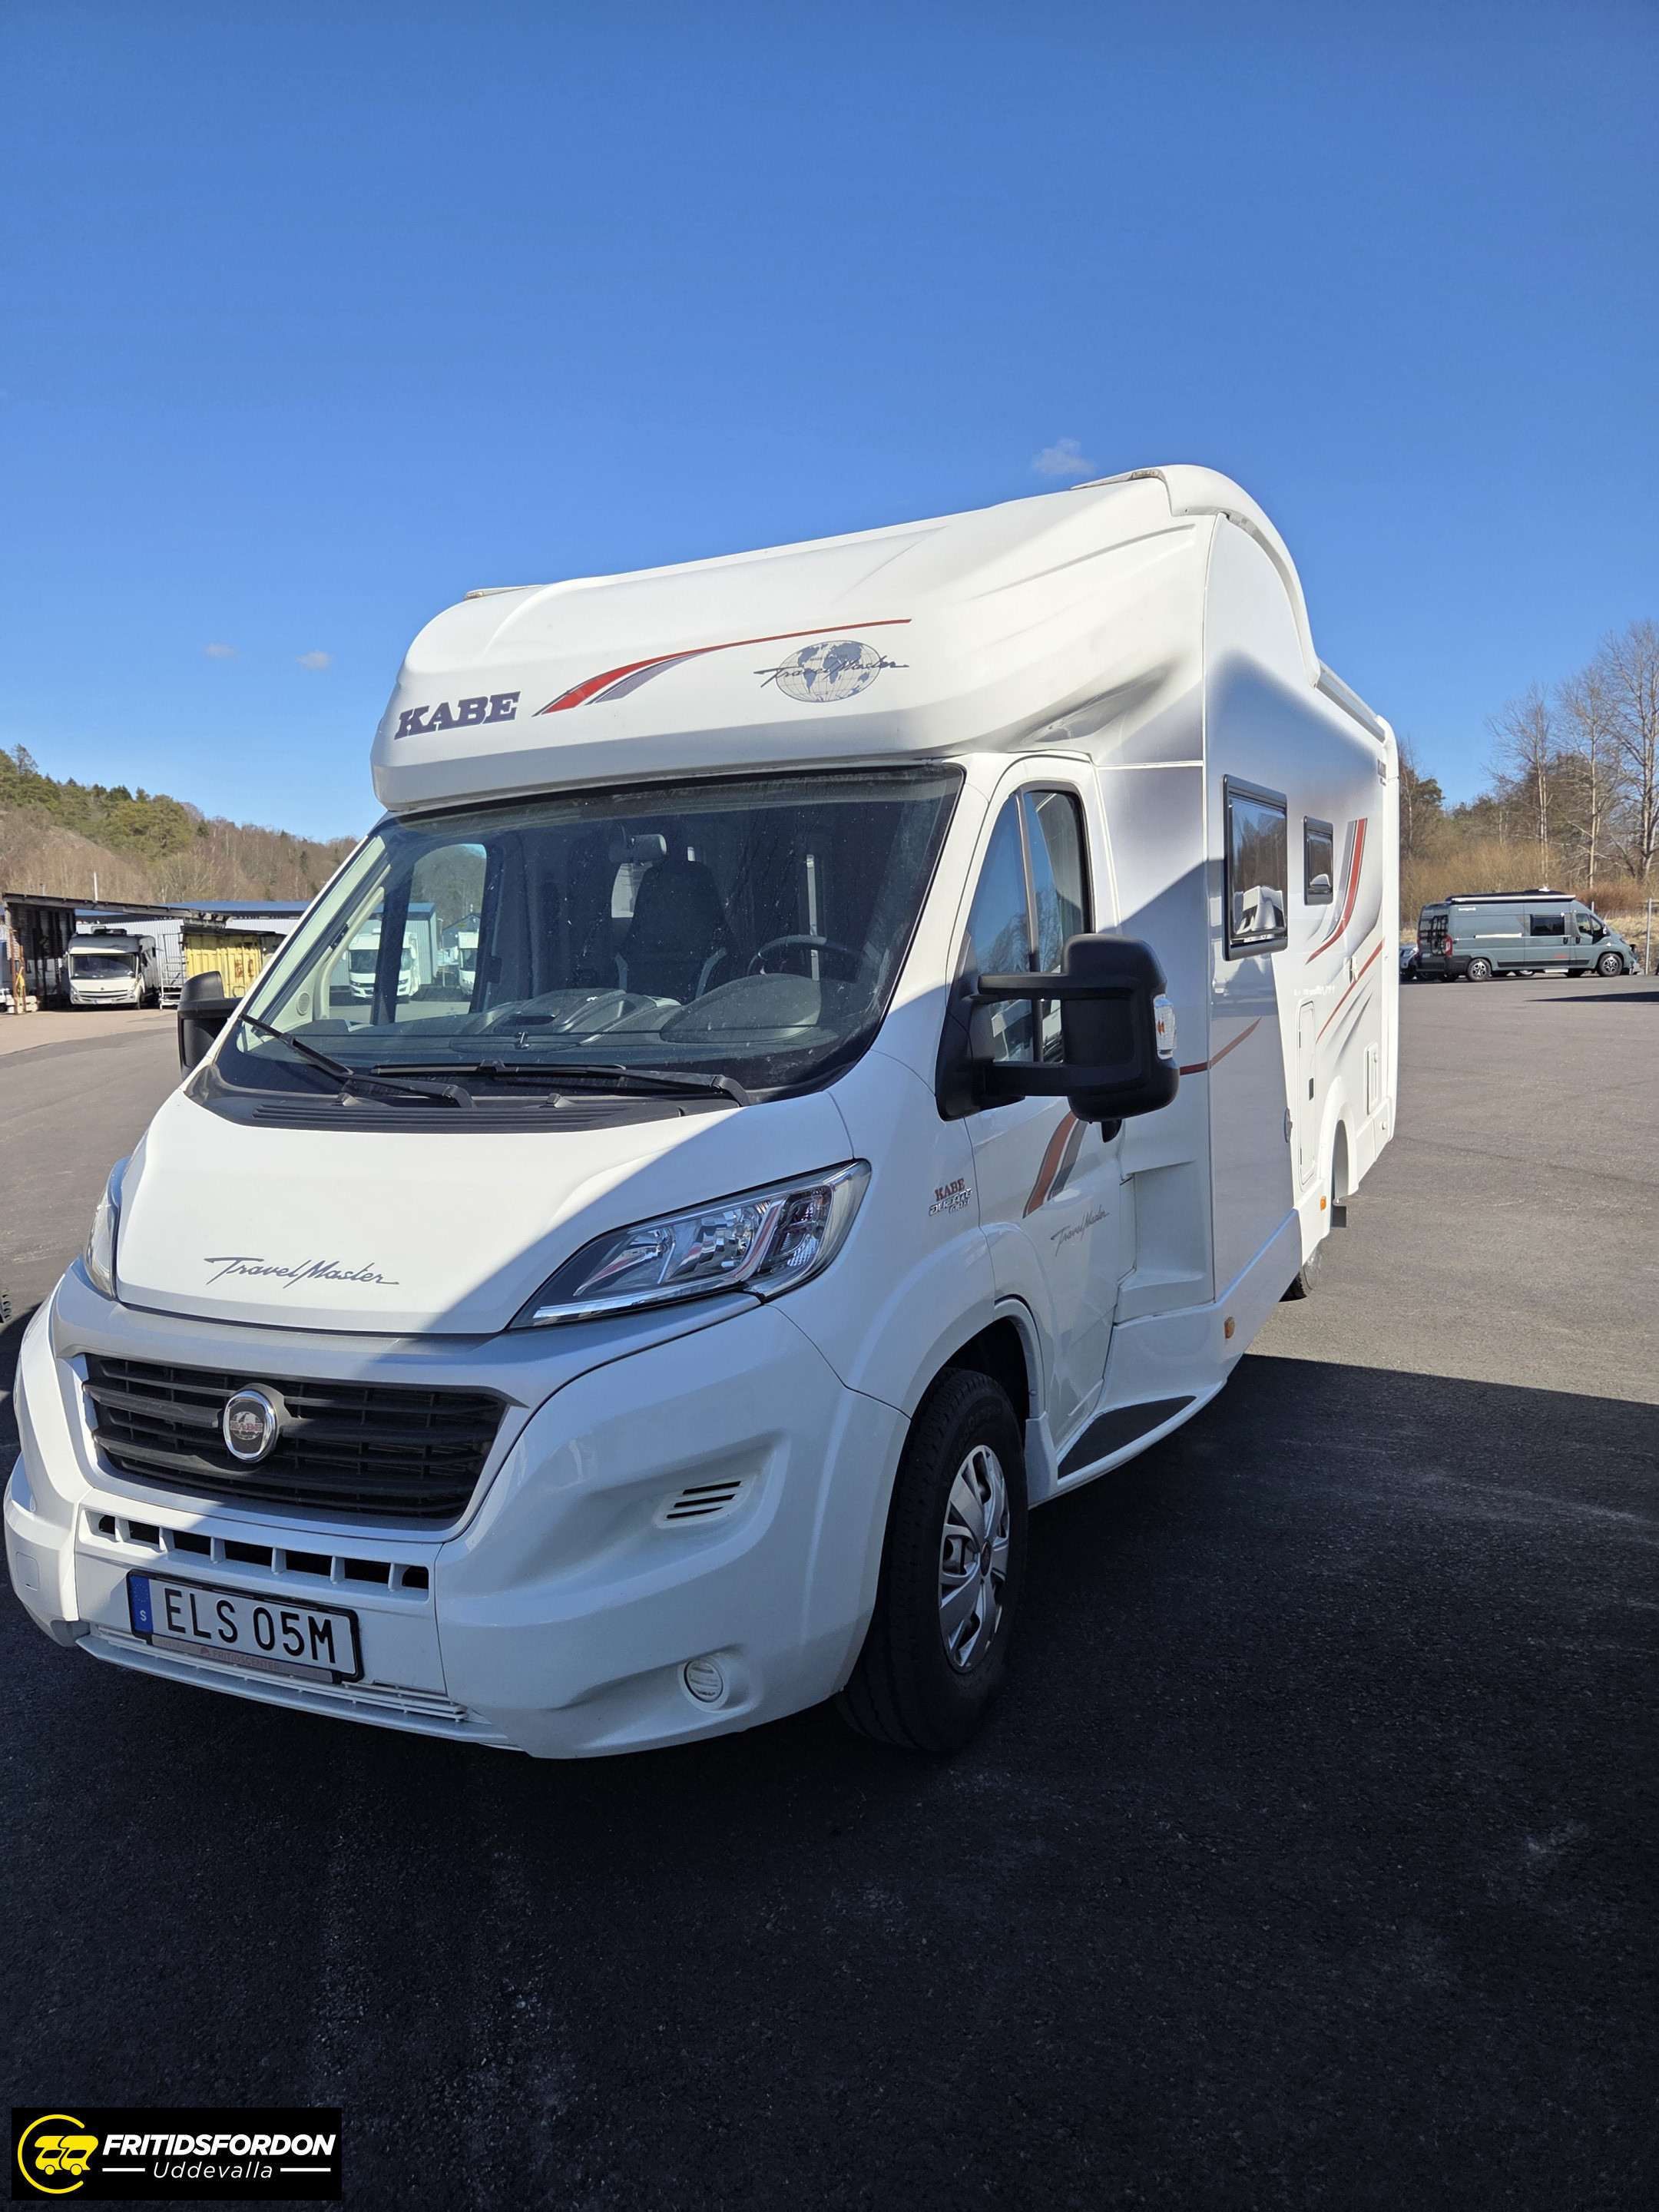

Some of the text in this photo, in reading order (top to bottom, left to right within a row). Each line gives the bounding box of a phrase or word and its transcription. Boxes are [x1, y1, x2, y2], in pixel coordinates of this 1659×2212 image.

[394, 690, 521, 740] KABE
[935, 1177, 965, 1202] KABE
[230, 1421, 263, 1432] KABE
[140, 1610, 147, 1621] S
[164, 1588, 336, 1664] ELS 05M
[213, 1650, 280, 1672] FRITIDSCENTER
